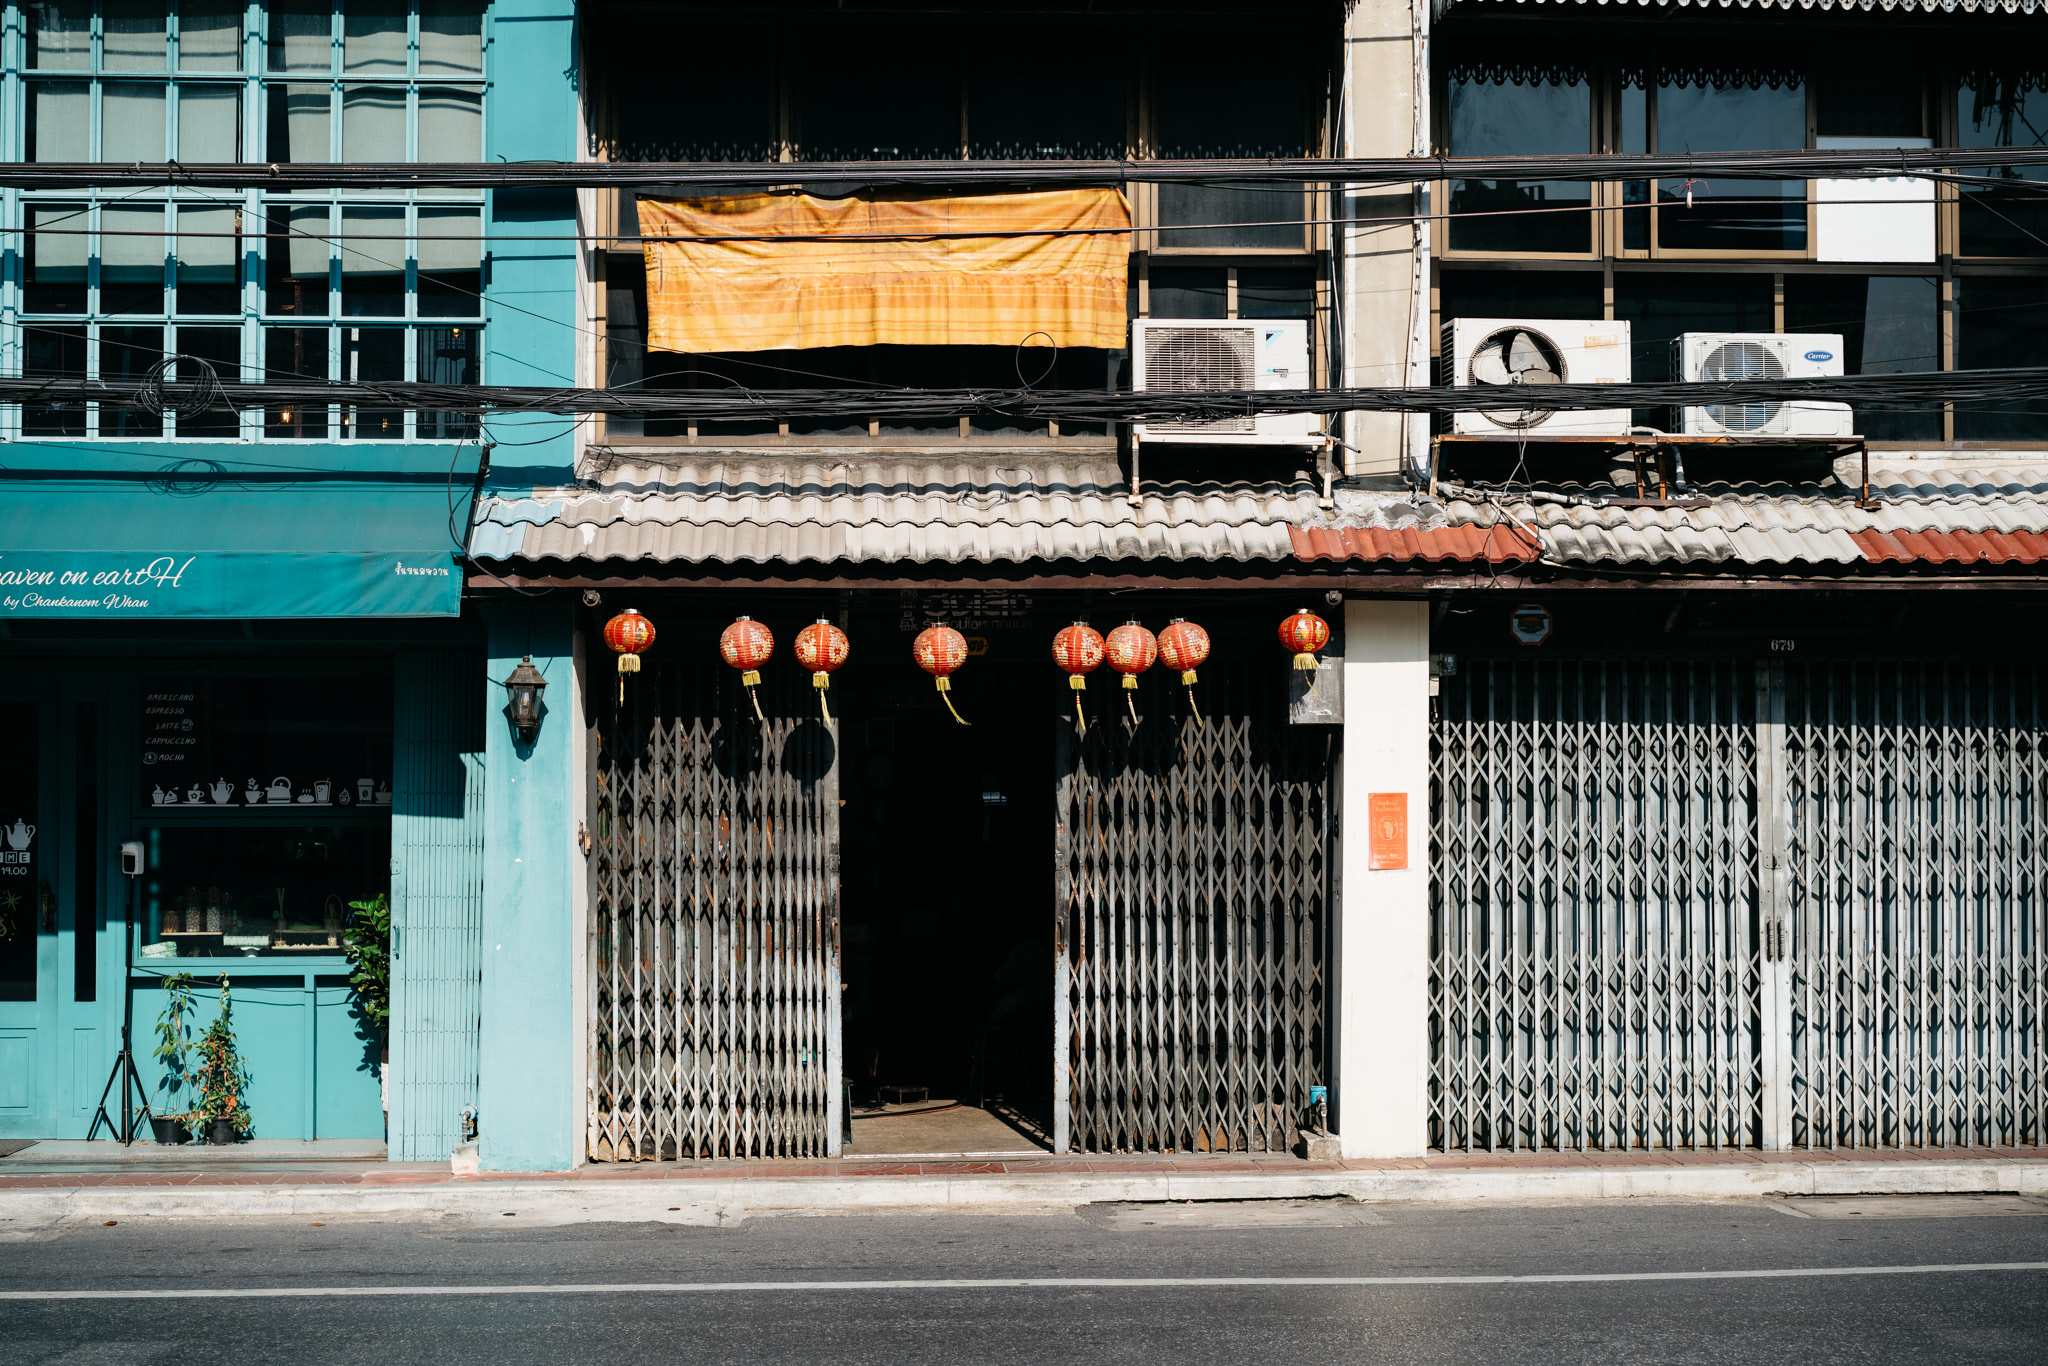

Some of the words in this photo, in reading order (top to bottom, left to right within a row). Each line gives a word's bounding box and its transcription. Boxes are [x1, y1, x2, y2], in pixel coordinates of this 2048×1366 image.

[1807, 352, 1830, 360] Carrier
[0, 568, 56, 586] aven
[60, 570, 89, 585] on
[92, 556, 196, 588] eartH
[3, 595, 19, 610] by
[22, 593, 100, 608] Chankanom
[102, 594, 149, 609] Whan
[1770, 638, 1795, 652] 679
[145, 706, 185, 715] ESPRESSO
[155, 722, 180, 730] LATTE
[145, 737, 196, 745] CAPPUCCINO
[158, 753, 185, 761] MOCHA
[1, 866, 28, 876] 19.00
